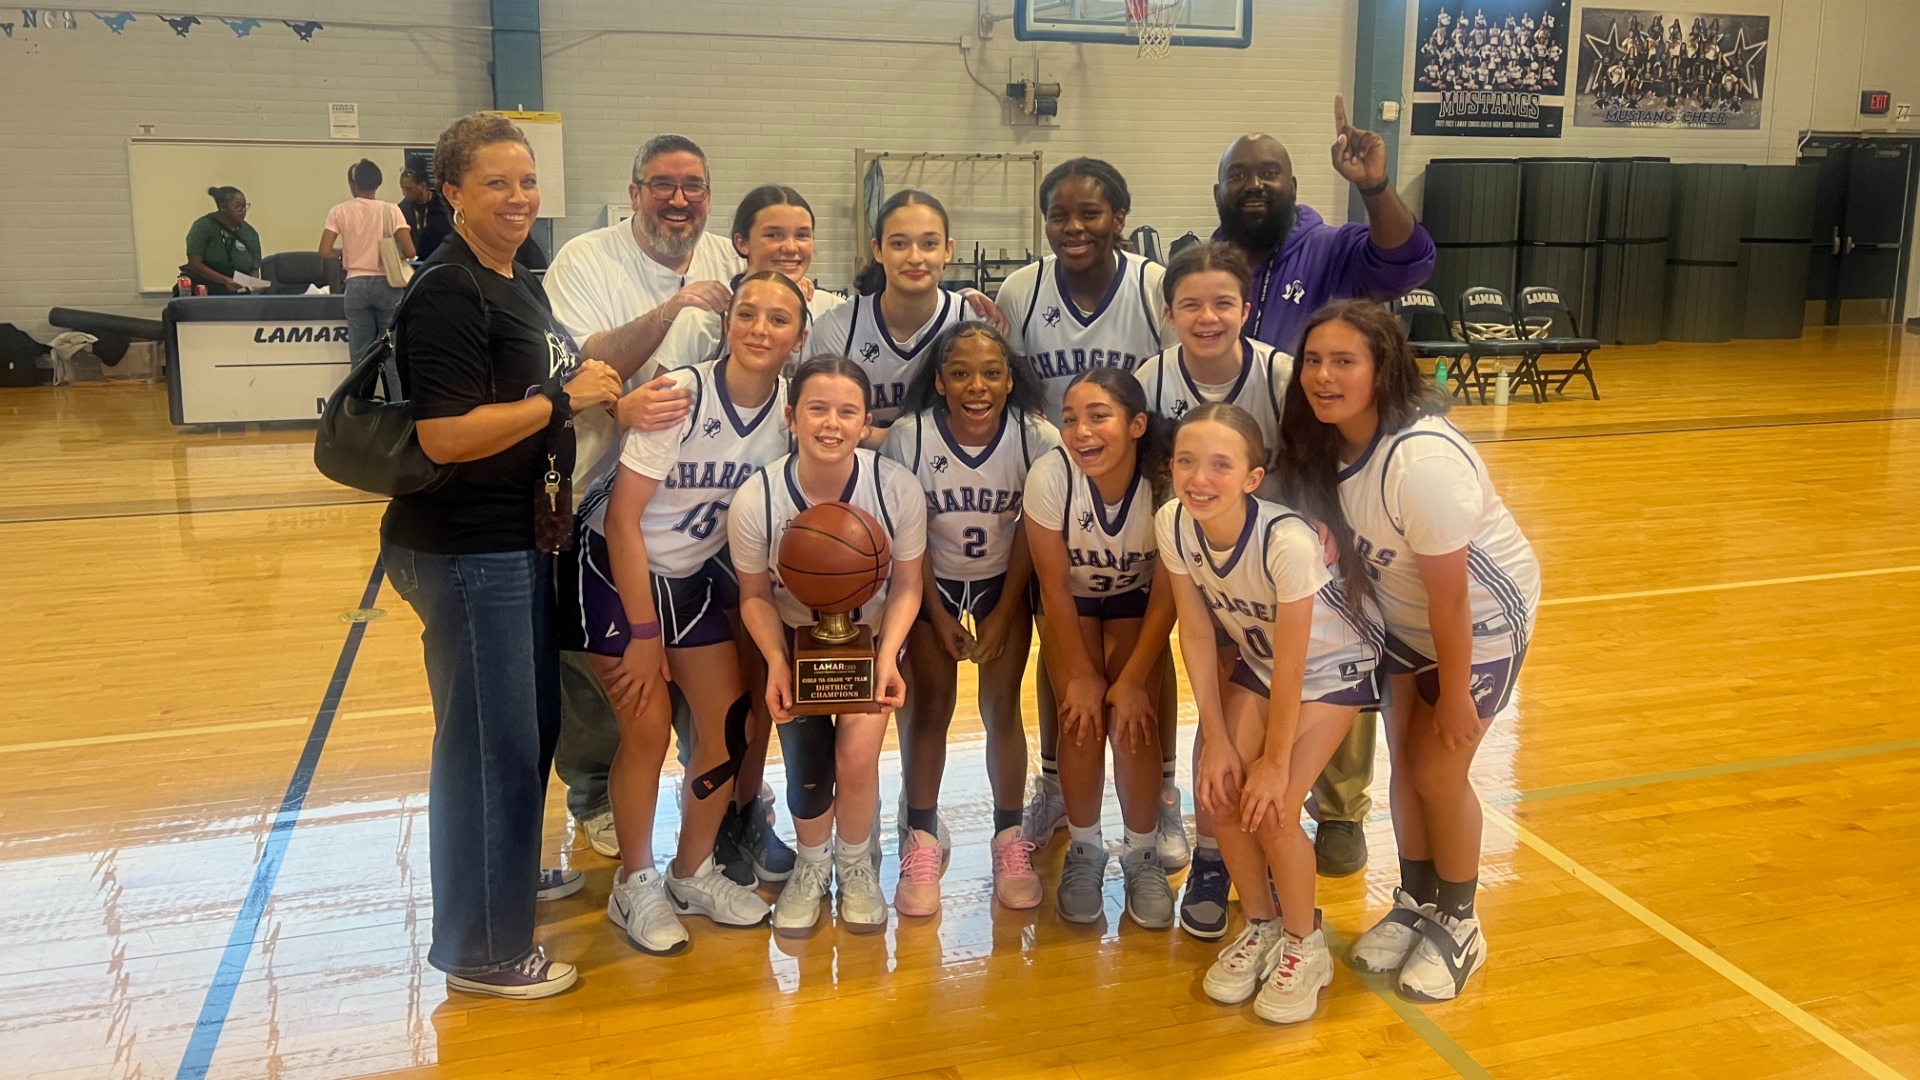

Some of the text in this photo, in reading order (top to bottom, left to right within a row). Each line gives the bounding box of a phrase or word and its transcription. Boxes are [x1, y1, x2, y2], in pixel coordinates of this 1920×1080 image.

[1439, 91, 1540, 119] MUSTANGS
[1870, 94, 1888, 110] EXIT
[1604, 109, 1675, 123] MUSTANG
[1682, 111, 1726, 125] CHEER
[1897, 105, 1910, 120] 77
[1455, 120, 1467, 128] LAMAR
[1401, 295, 1435, 307] LAMAR
[1468, 293, 1503, 306] LAMAR
[1526, 292, 1560, 305] LAMAR
[254, 326, 348, 343] LAMAR
[671, 500, 729, 541] 15
[962, 526, 987, 559] 2
[1087, 574, 1140, 592] 33
[1242, 625, 1274, 660] 0
[810, 691, 859, 699] CHAMPIONS
